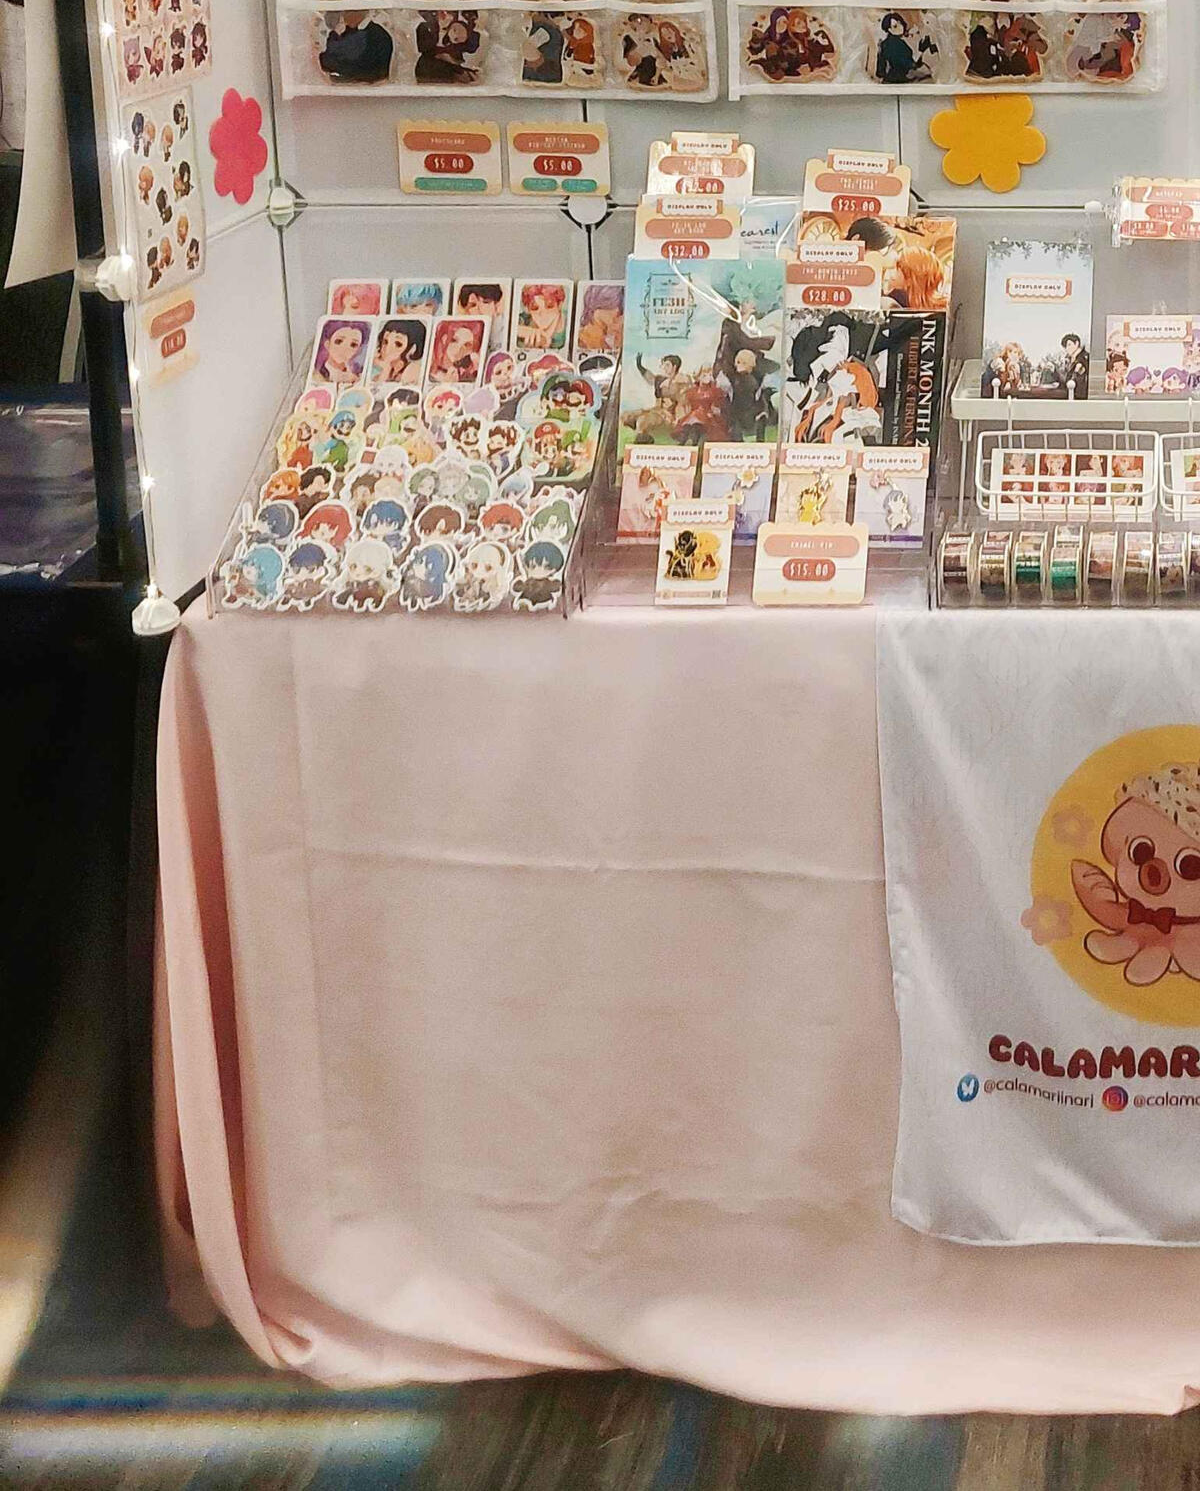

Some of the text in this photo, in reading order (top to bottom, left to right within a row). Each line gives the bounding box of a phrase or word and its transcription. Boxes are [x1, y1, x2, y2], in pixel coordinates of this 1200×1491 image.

[434, 157, 464, 169] $5.00
[543, 159, 573, 171] $5.00
[838, 198, 875, 212] $25.00
[808, 289, 845, 302] $28.00
[920, 319, 938, 354] INK
[907, 336, 920, 382] HUBERT
[915, 359, 936, 433] MONTH
[635, 454, 665, 462] DISPLAY
[789, 562, 829, 577] $15.00
[983, 1076, 1094, 1107] @calamariinari
